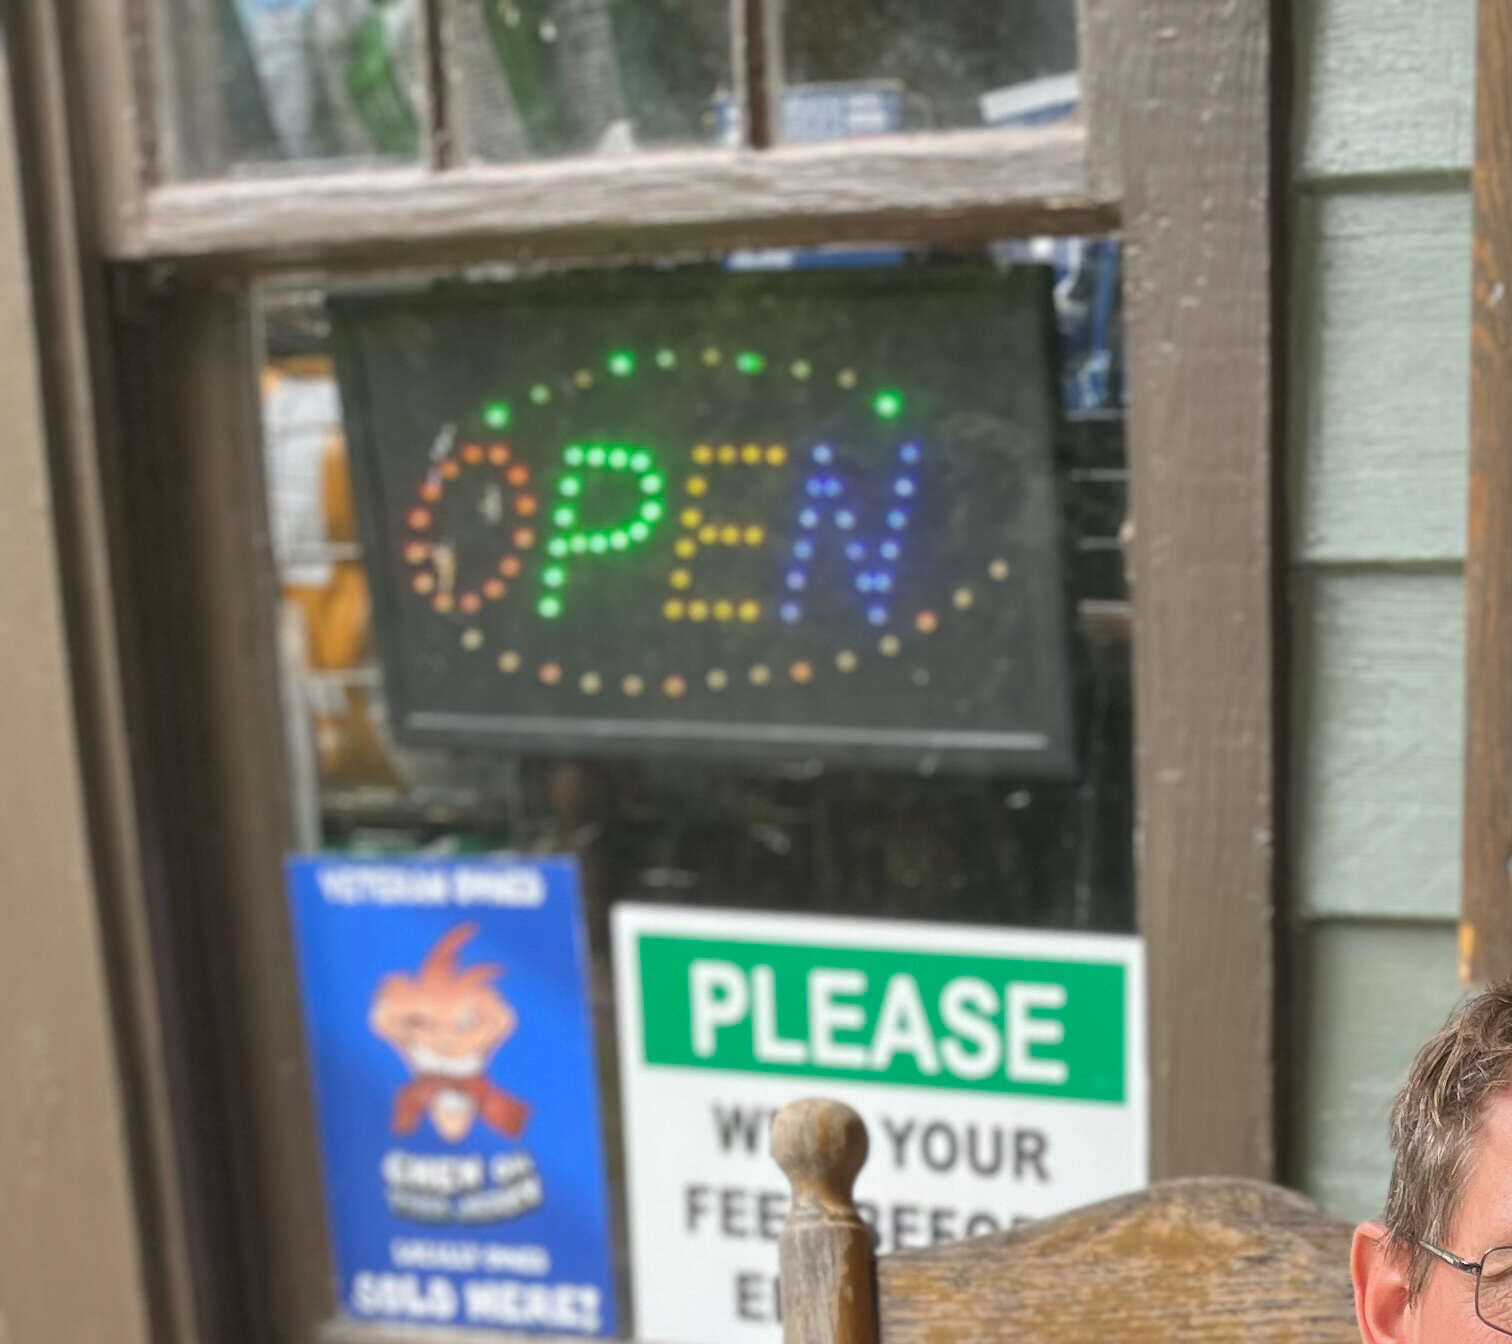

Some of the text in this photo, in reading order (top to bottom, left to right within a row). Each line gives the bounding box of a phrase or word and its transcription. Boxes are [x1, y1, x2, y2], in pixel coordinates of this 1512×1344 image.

[404, 441, 923, 628] OPEN
[687, 959, 1069, 1085] PLEASE
[882, 1117, 1050, 1182] YOUR
[685, 1185, 787, 1241] FEE
